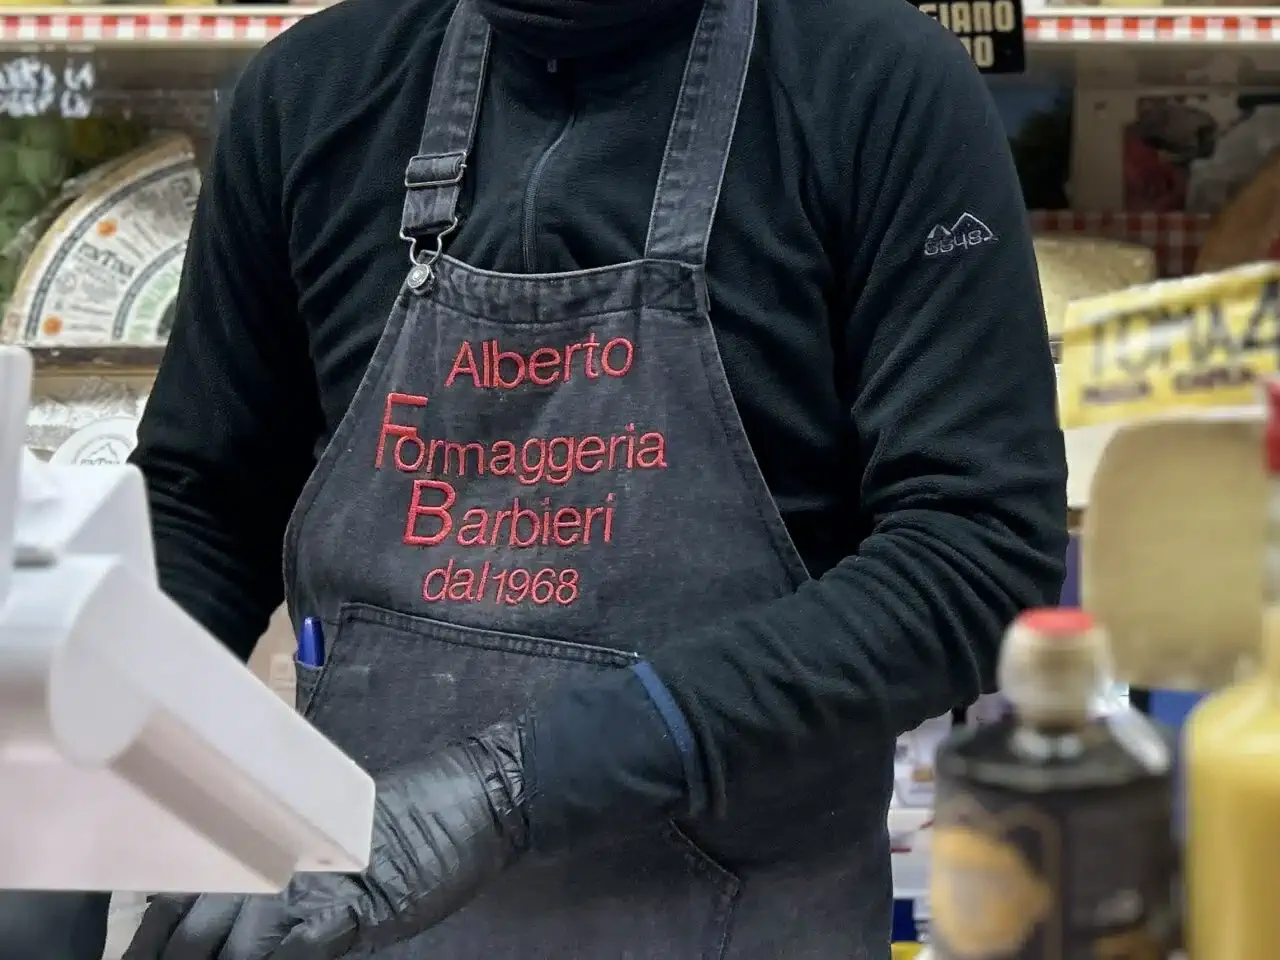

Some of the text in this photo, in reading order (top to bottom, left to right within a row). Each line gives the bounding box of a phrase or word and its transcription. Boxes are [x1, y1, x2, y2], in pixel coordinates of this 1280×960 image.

[444, 332, 635, 389] Alberto
[375, 392, 668, 485] Formaggeria
[403, 479, 617, 548] Barbieri
[422, 559, 580, 606] dal 1968
